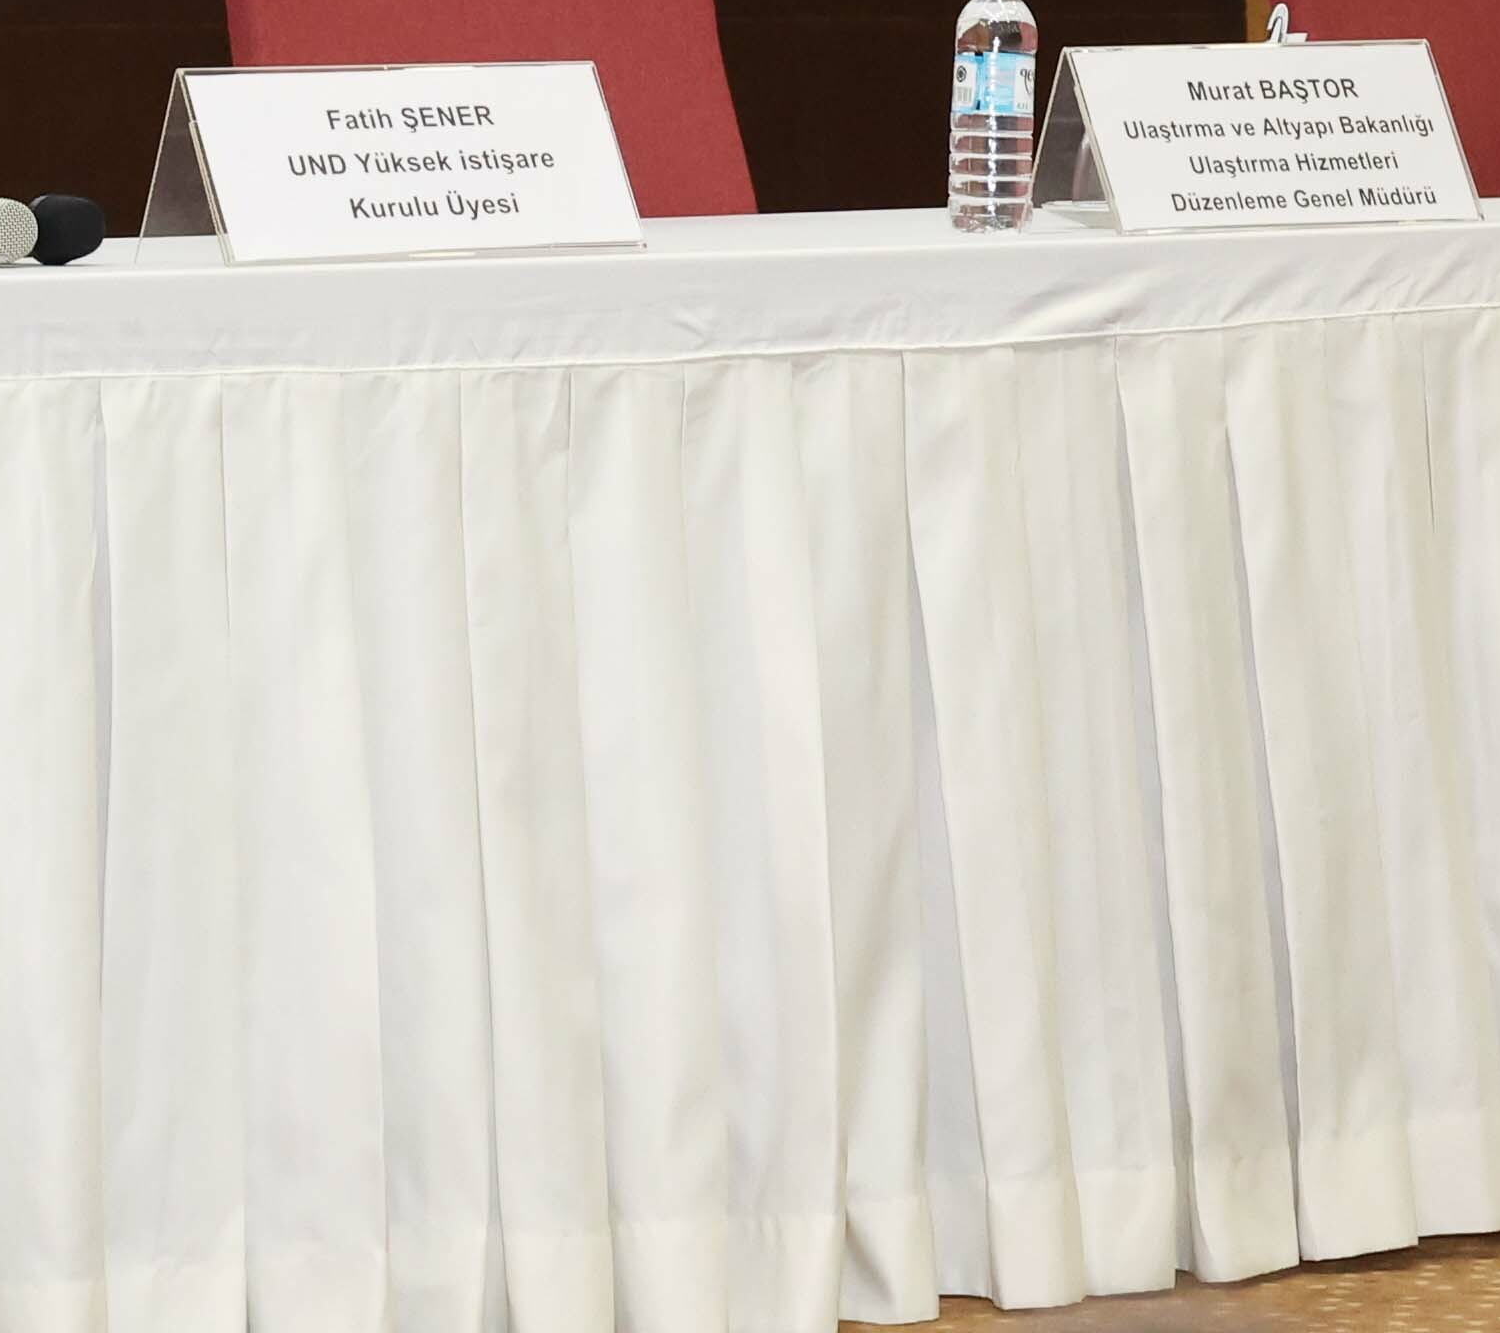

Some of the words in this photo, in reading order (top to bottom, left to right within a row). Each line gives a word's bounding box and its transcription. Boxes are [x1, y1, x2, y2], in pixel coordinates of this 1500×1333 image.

[1187, 81, 1255, 101] Murat
[1259, 78, 1359, 104] BAŞTOR
[326, 107, 394, 131] Fatih
[401, 105, 495, 133] ŞENER
[1123, 119, 1225, 143] Ulaştırma
[1231, 121, 1256, 136] ve
[1263, 117, 1334, 140] Altyapı
[1339, 113, 1435, 137] Bakanlığı
[288, 153, 347, 177] UND
[355, 150, 453, 175] Yüksek
[460, 149, 555, 175] istişare
[1189, 155, 1290, 178] Ulaştırma
[1295, 151, 1399, 172] Hizmetleri
[350, 194, 439, 220] Kurulu
[446, 190, 520, 221] Üyesi
[1171, 191, 1287, 212] Düzenleme
[1294, 188, 1353, 209] Genel
[1358, 185, 1437, 207] Müdürü
